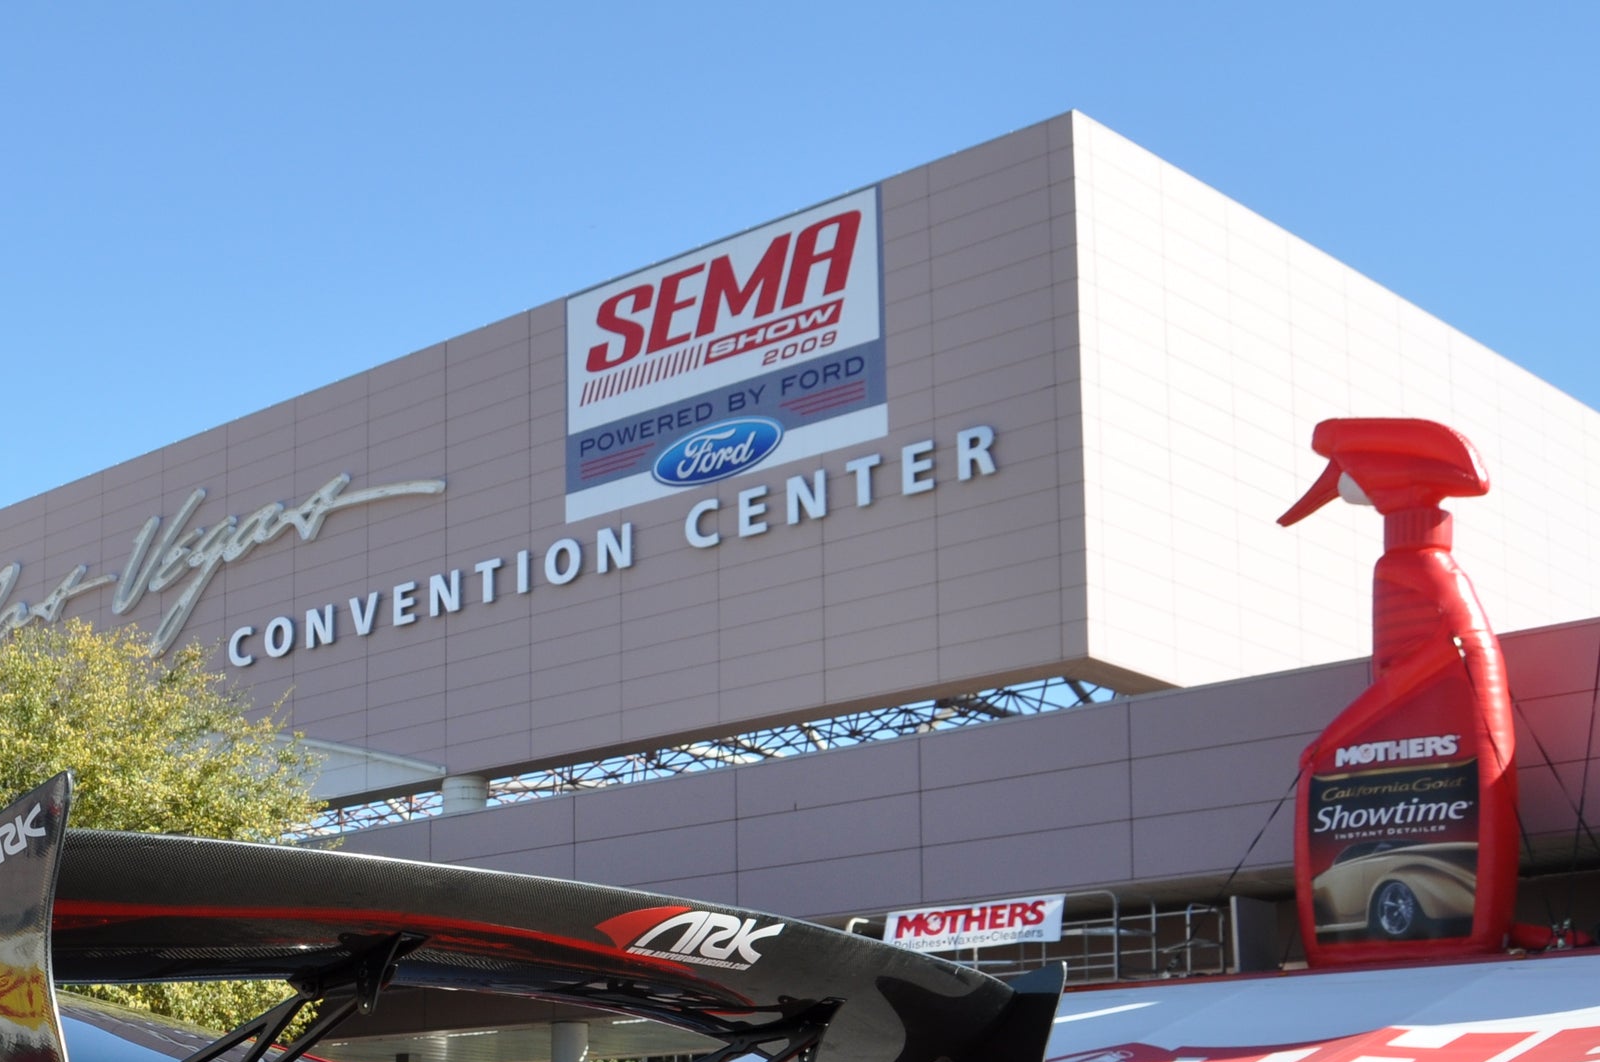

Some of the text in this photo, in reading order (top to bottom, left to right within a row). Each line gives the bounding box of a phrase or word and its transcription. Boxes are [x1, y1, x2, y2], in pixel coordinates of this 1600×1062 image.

[586, 209, 862, 373] SEMA
[708, 304, 838, 361] SHOW
[762, 330, 838, 367] 2009
[580, 355, 865, 457] POWERED BY FORD
[675, 427, 758, 480] Ford
[111, 473, 447, 661] Vegas
[228, 425, 998, 668] CONVENTION CENTER
[1334, 734, 1460, 768] MOTHERS
[1313, 797, 1469, 833] Showtime
[634, 910, 787, 964] ARK
[894, 900, 1046, 939] MOTHERS
